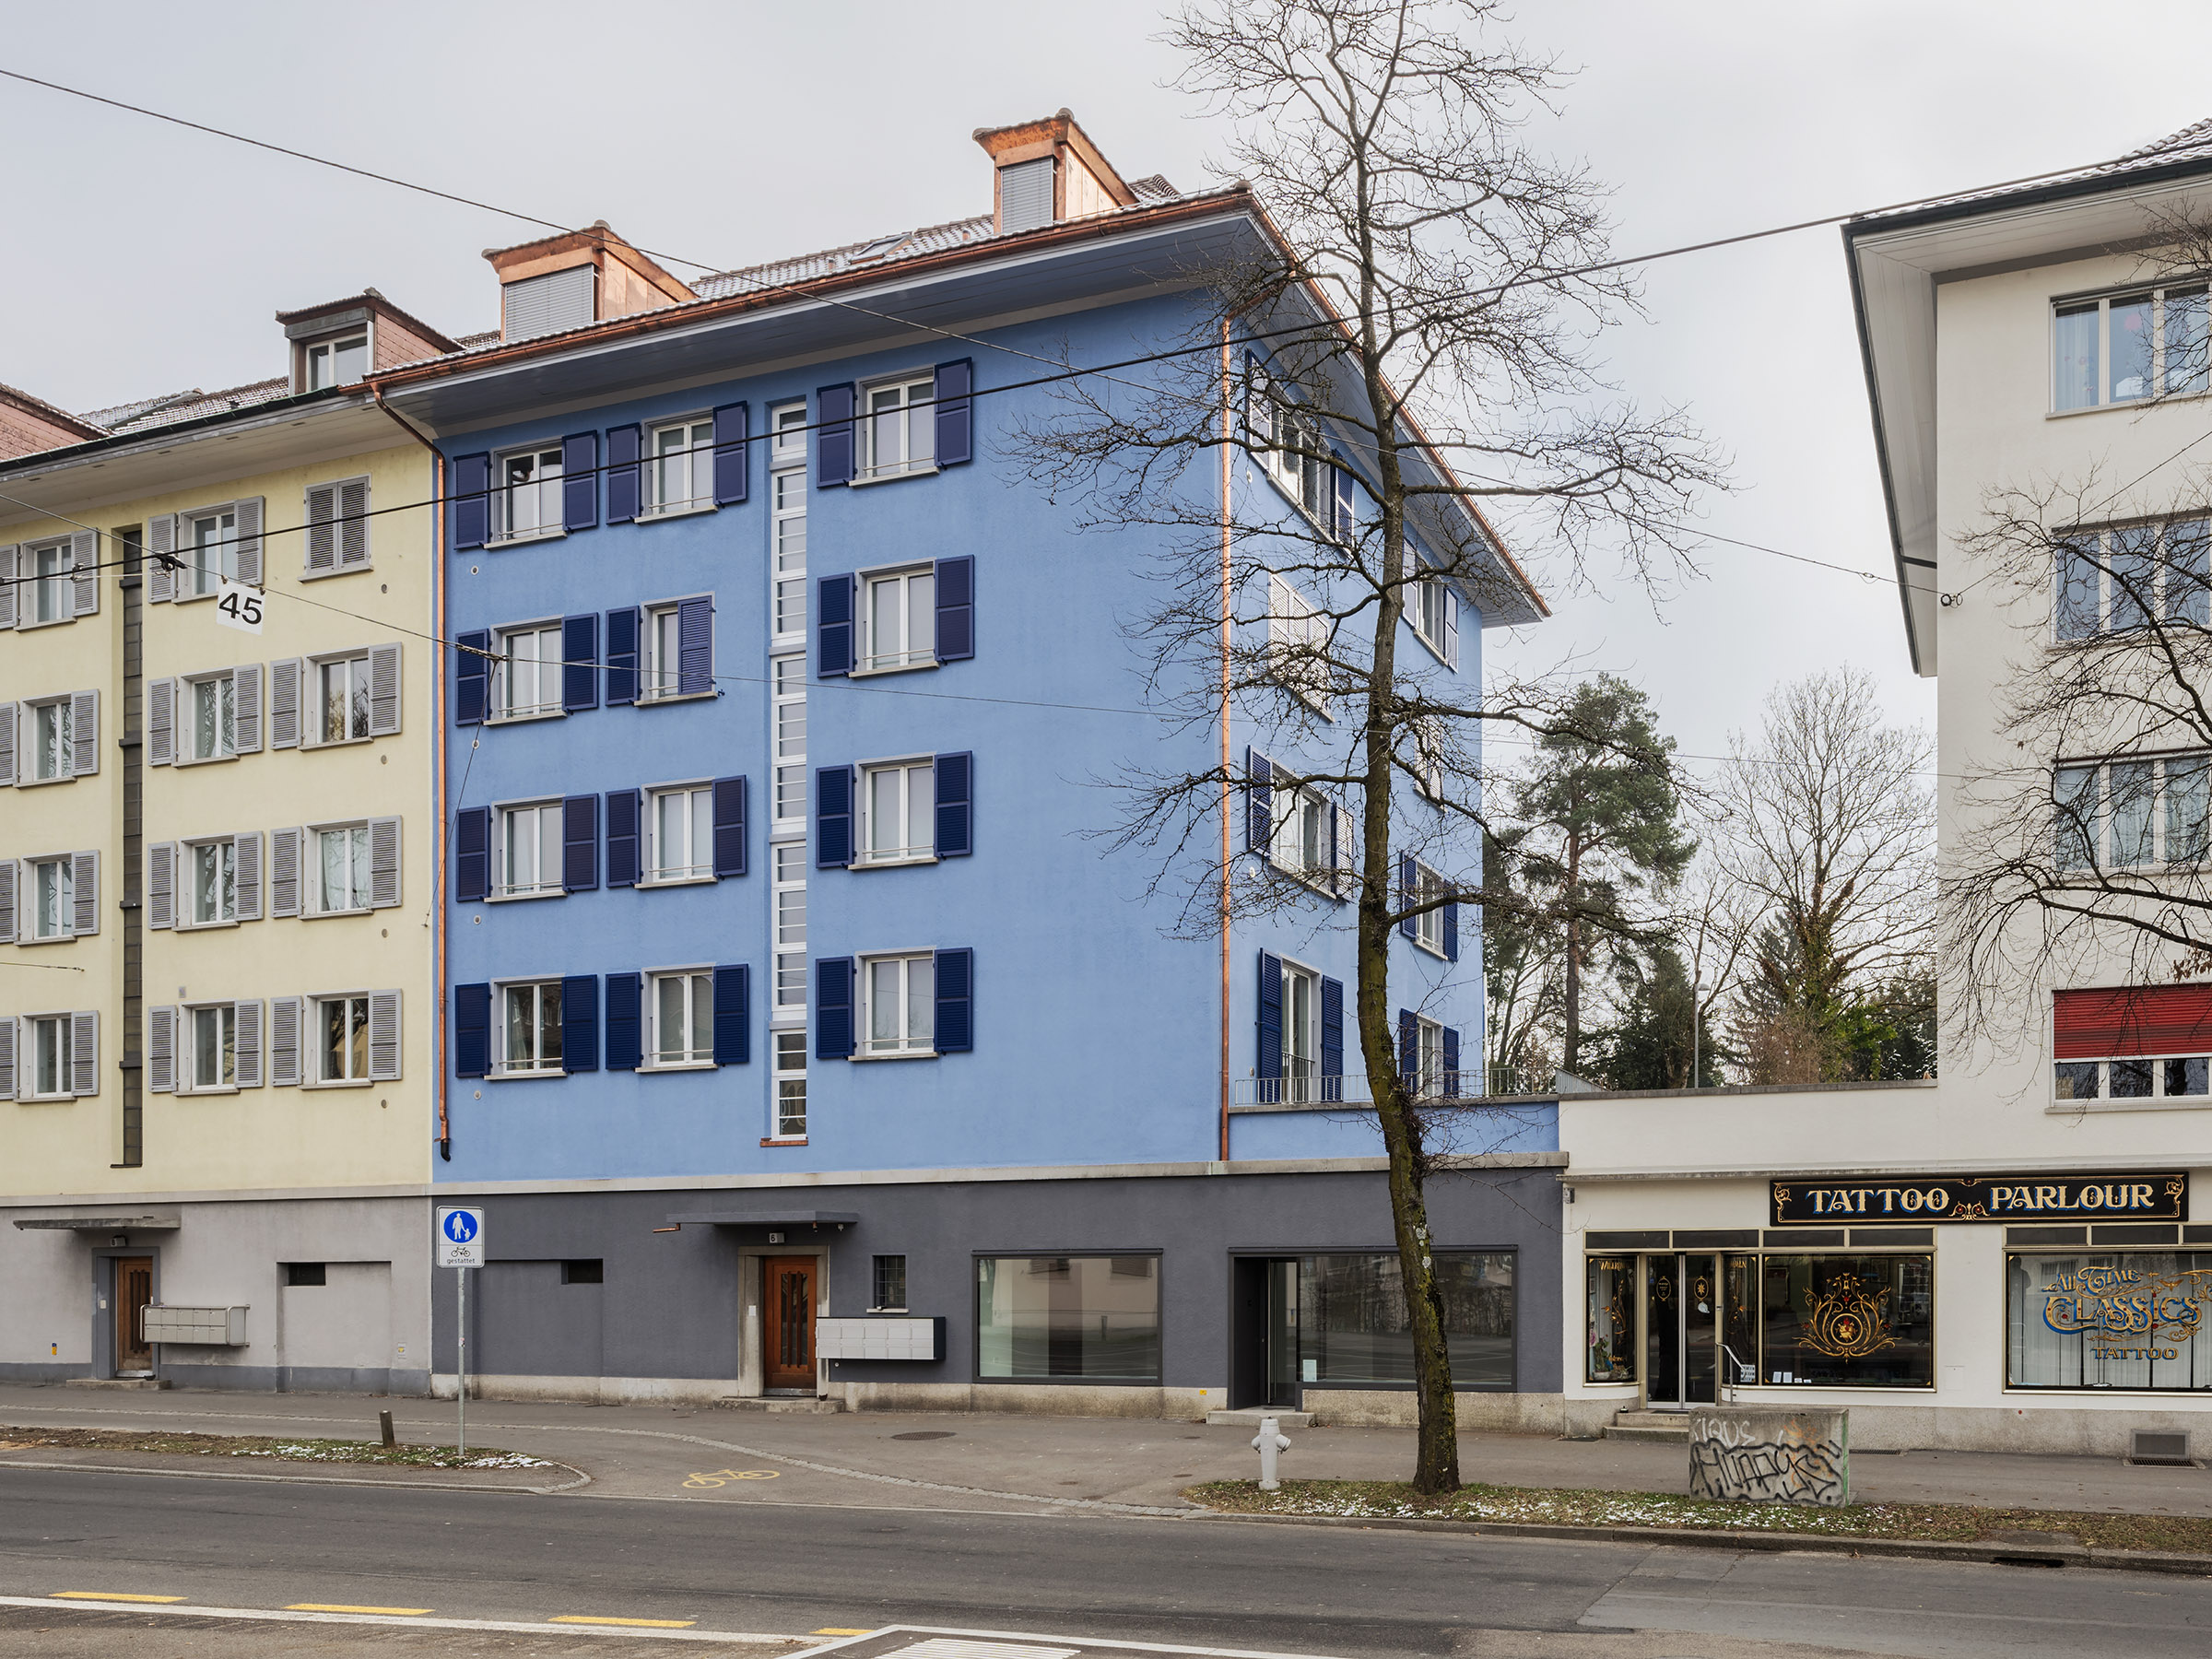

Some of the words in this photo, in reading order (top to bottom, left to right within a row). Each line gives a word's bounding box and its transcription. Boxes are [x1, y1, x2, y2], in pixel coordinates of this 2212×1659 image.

[218, 592, 263, 625] 45
[1806, 1187, 1950, 1214] TATTOO
[1989, 1183, 2155, 1212] PARLOUR
[2089, 1347, 2180, 1361] TATTOO
